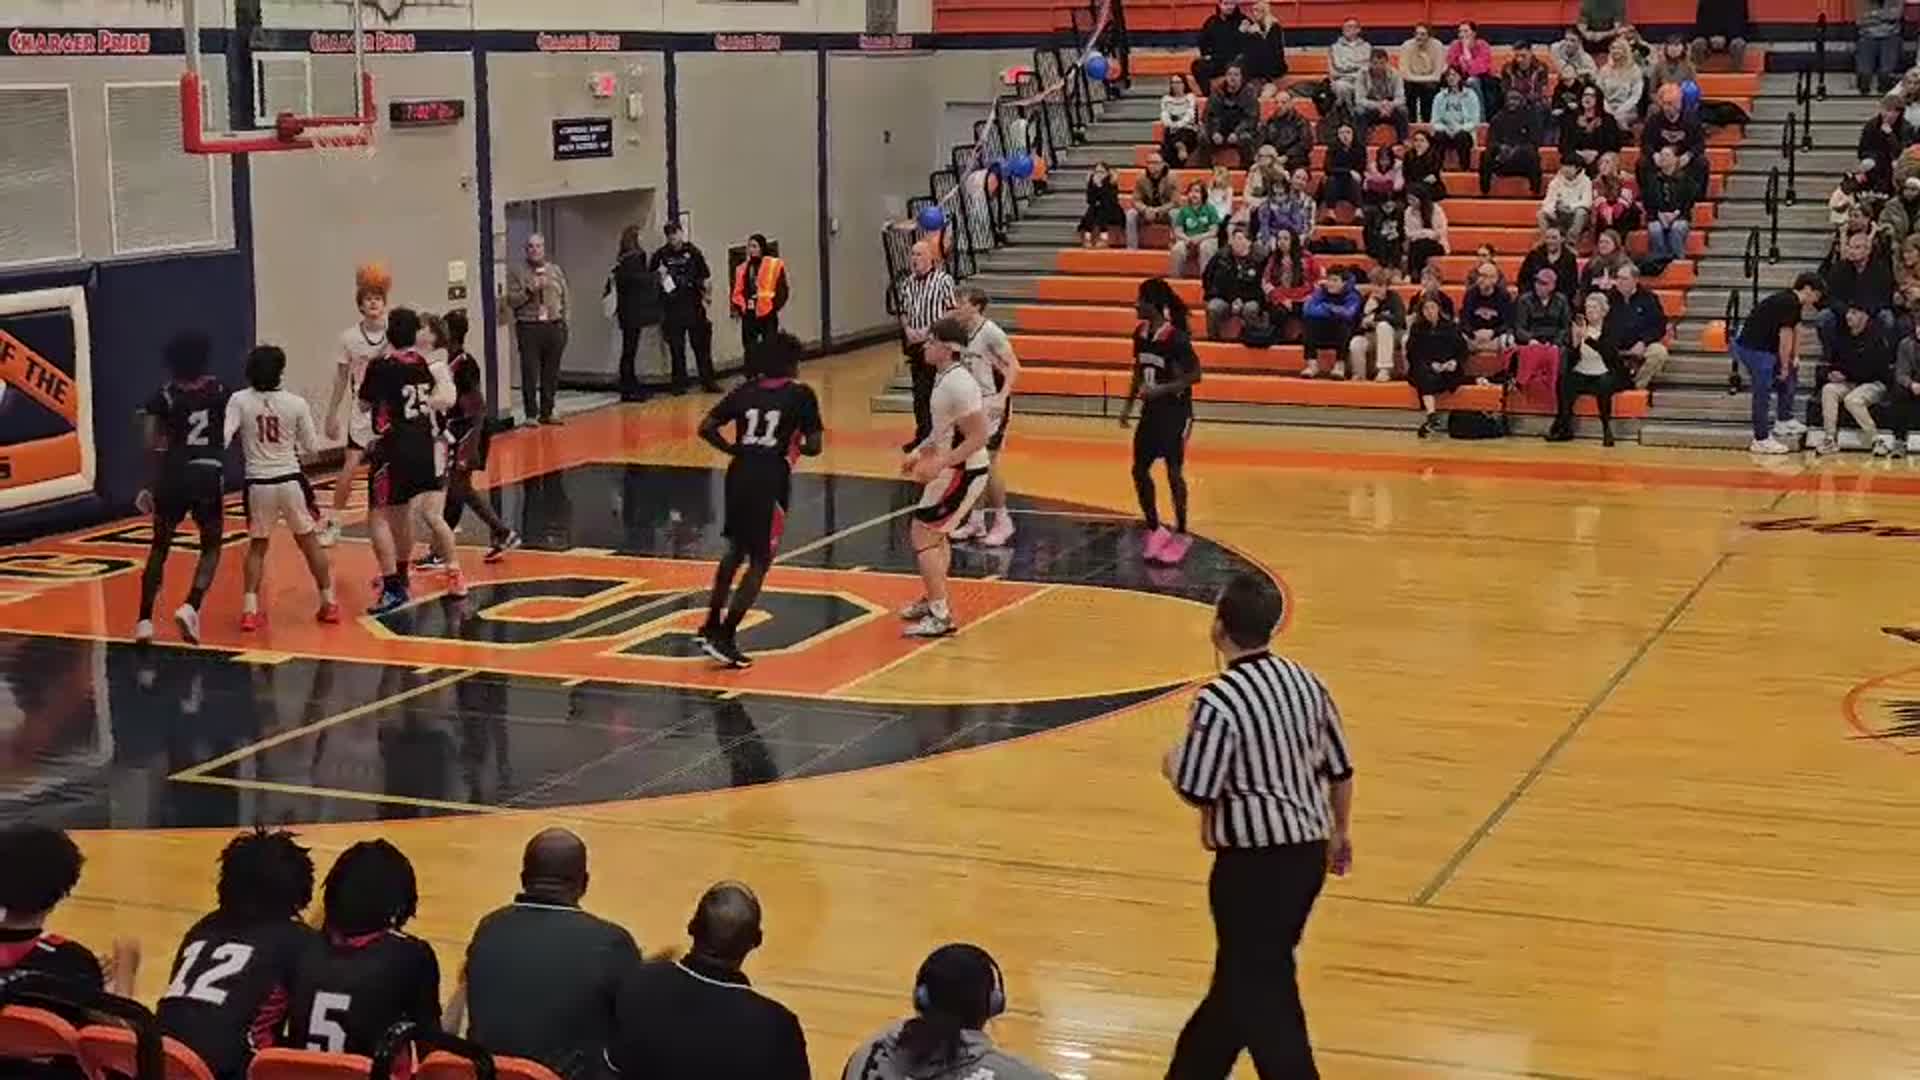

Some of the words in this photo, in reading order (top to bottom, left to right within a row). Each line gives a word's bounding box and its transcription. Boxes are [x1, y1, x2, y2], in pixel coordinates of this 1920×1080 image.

[8, 29, 96, 54] CHARGER
[97, 29, 150, 53] PRIDE
[25, 355, 69, 404] THE
[401, 382, 433, 419] 25
[186, 409, 209, 446] 2
[742, 408, 781, 447] 11
[163, 939, 255, 1006] 12
[306, 991, 352, 1054] 5
